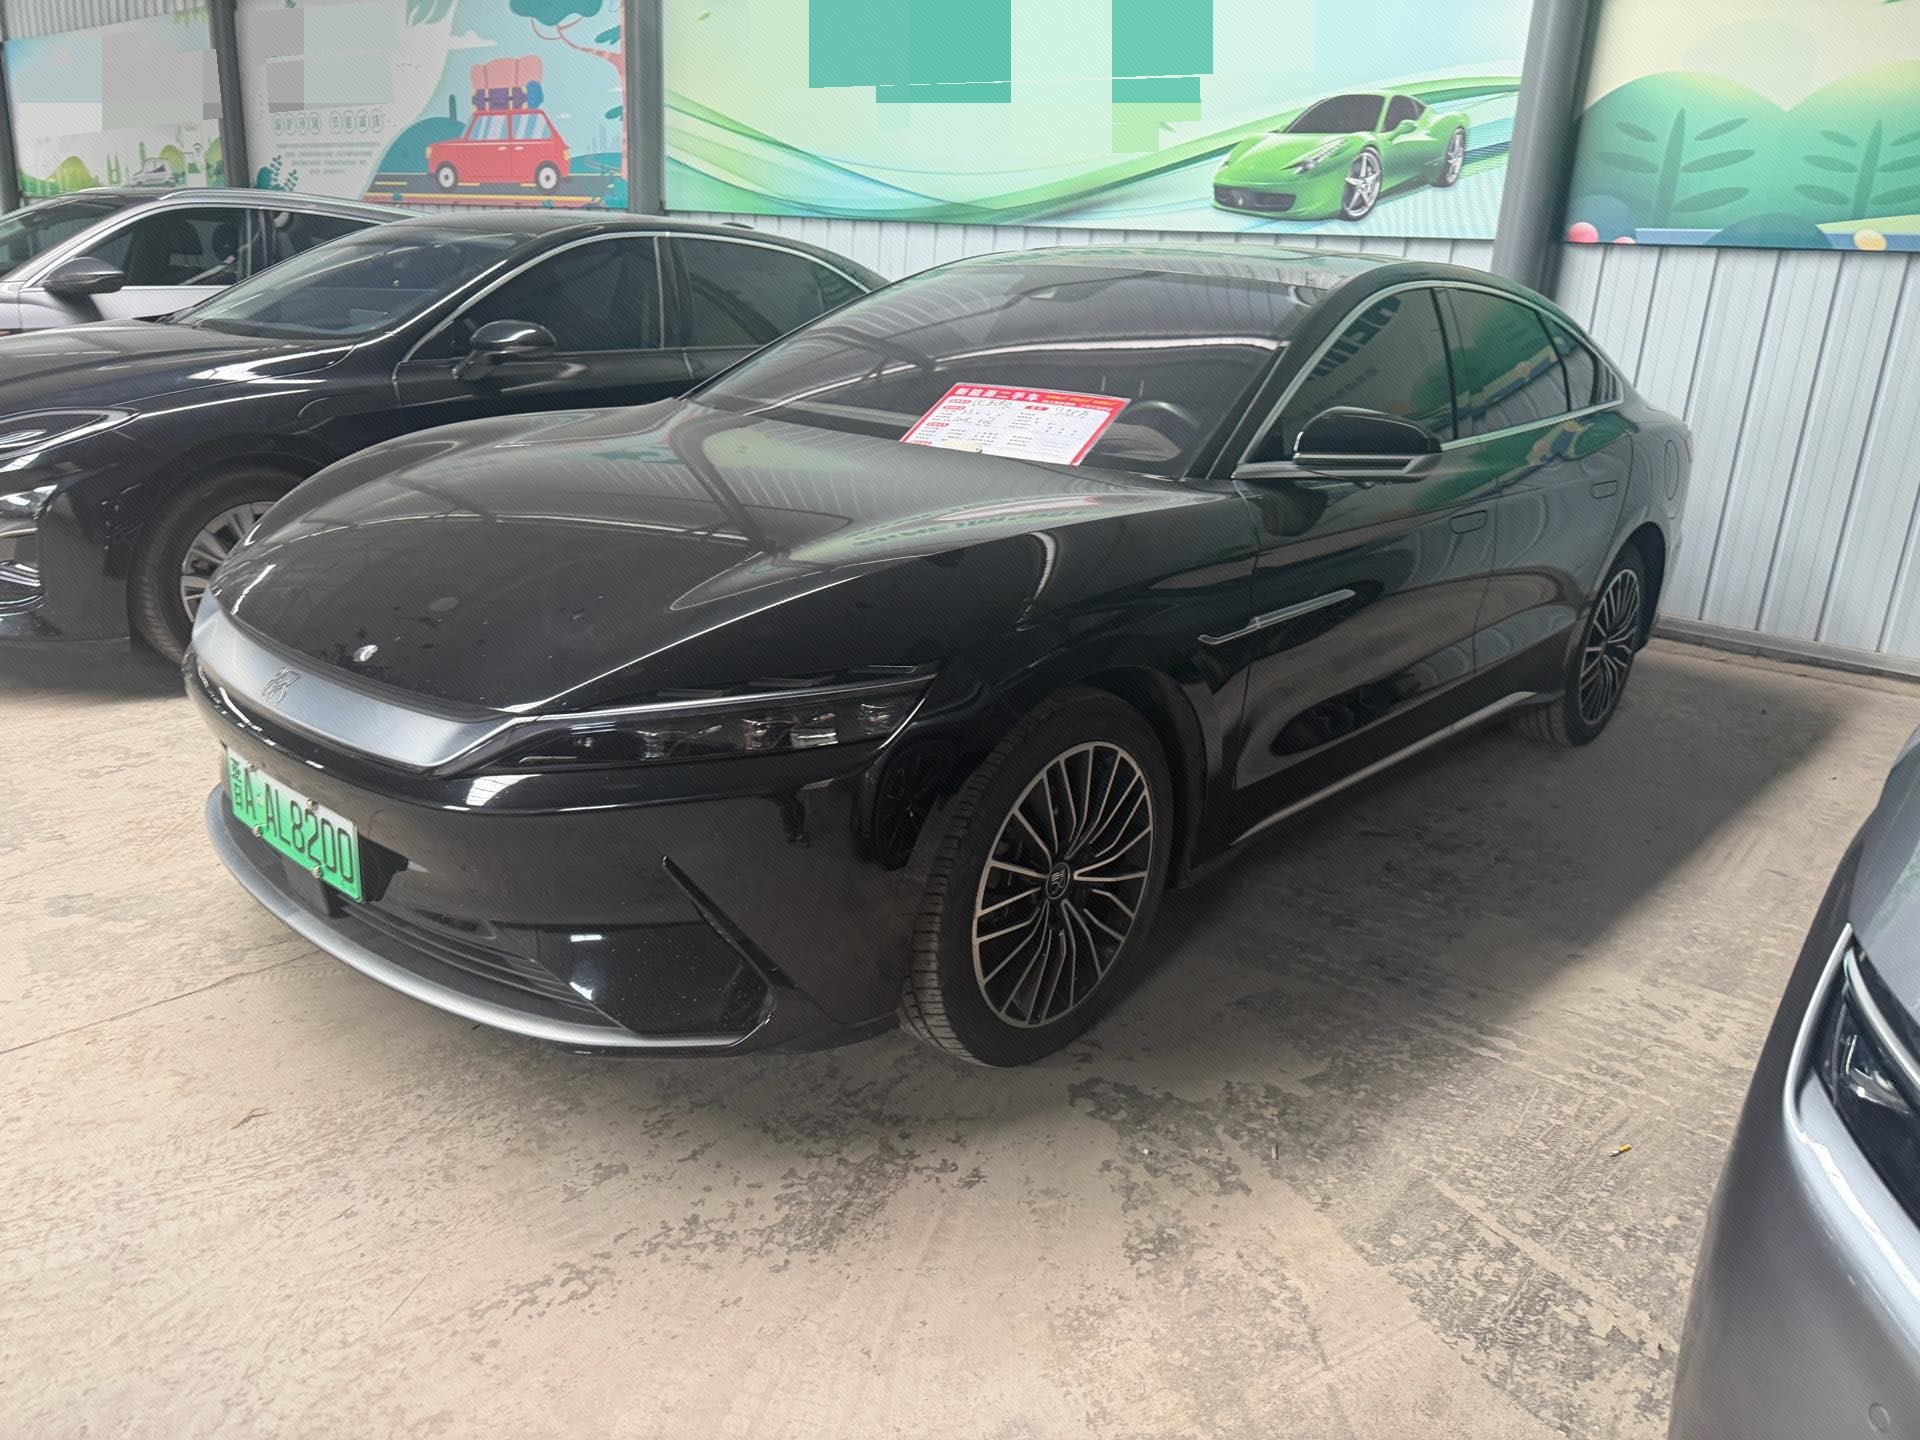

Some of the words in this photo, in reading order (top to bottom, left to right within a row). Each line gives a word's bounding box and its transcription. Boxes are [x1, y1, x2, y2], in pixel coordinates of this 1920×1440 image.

[955, 387, 1041, 402] 新能源二手车
